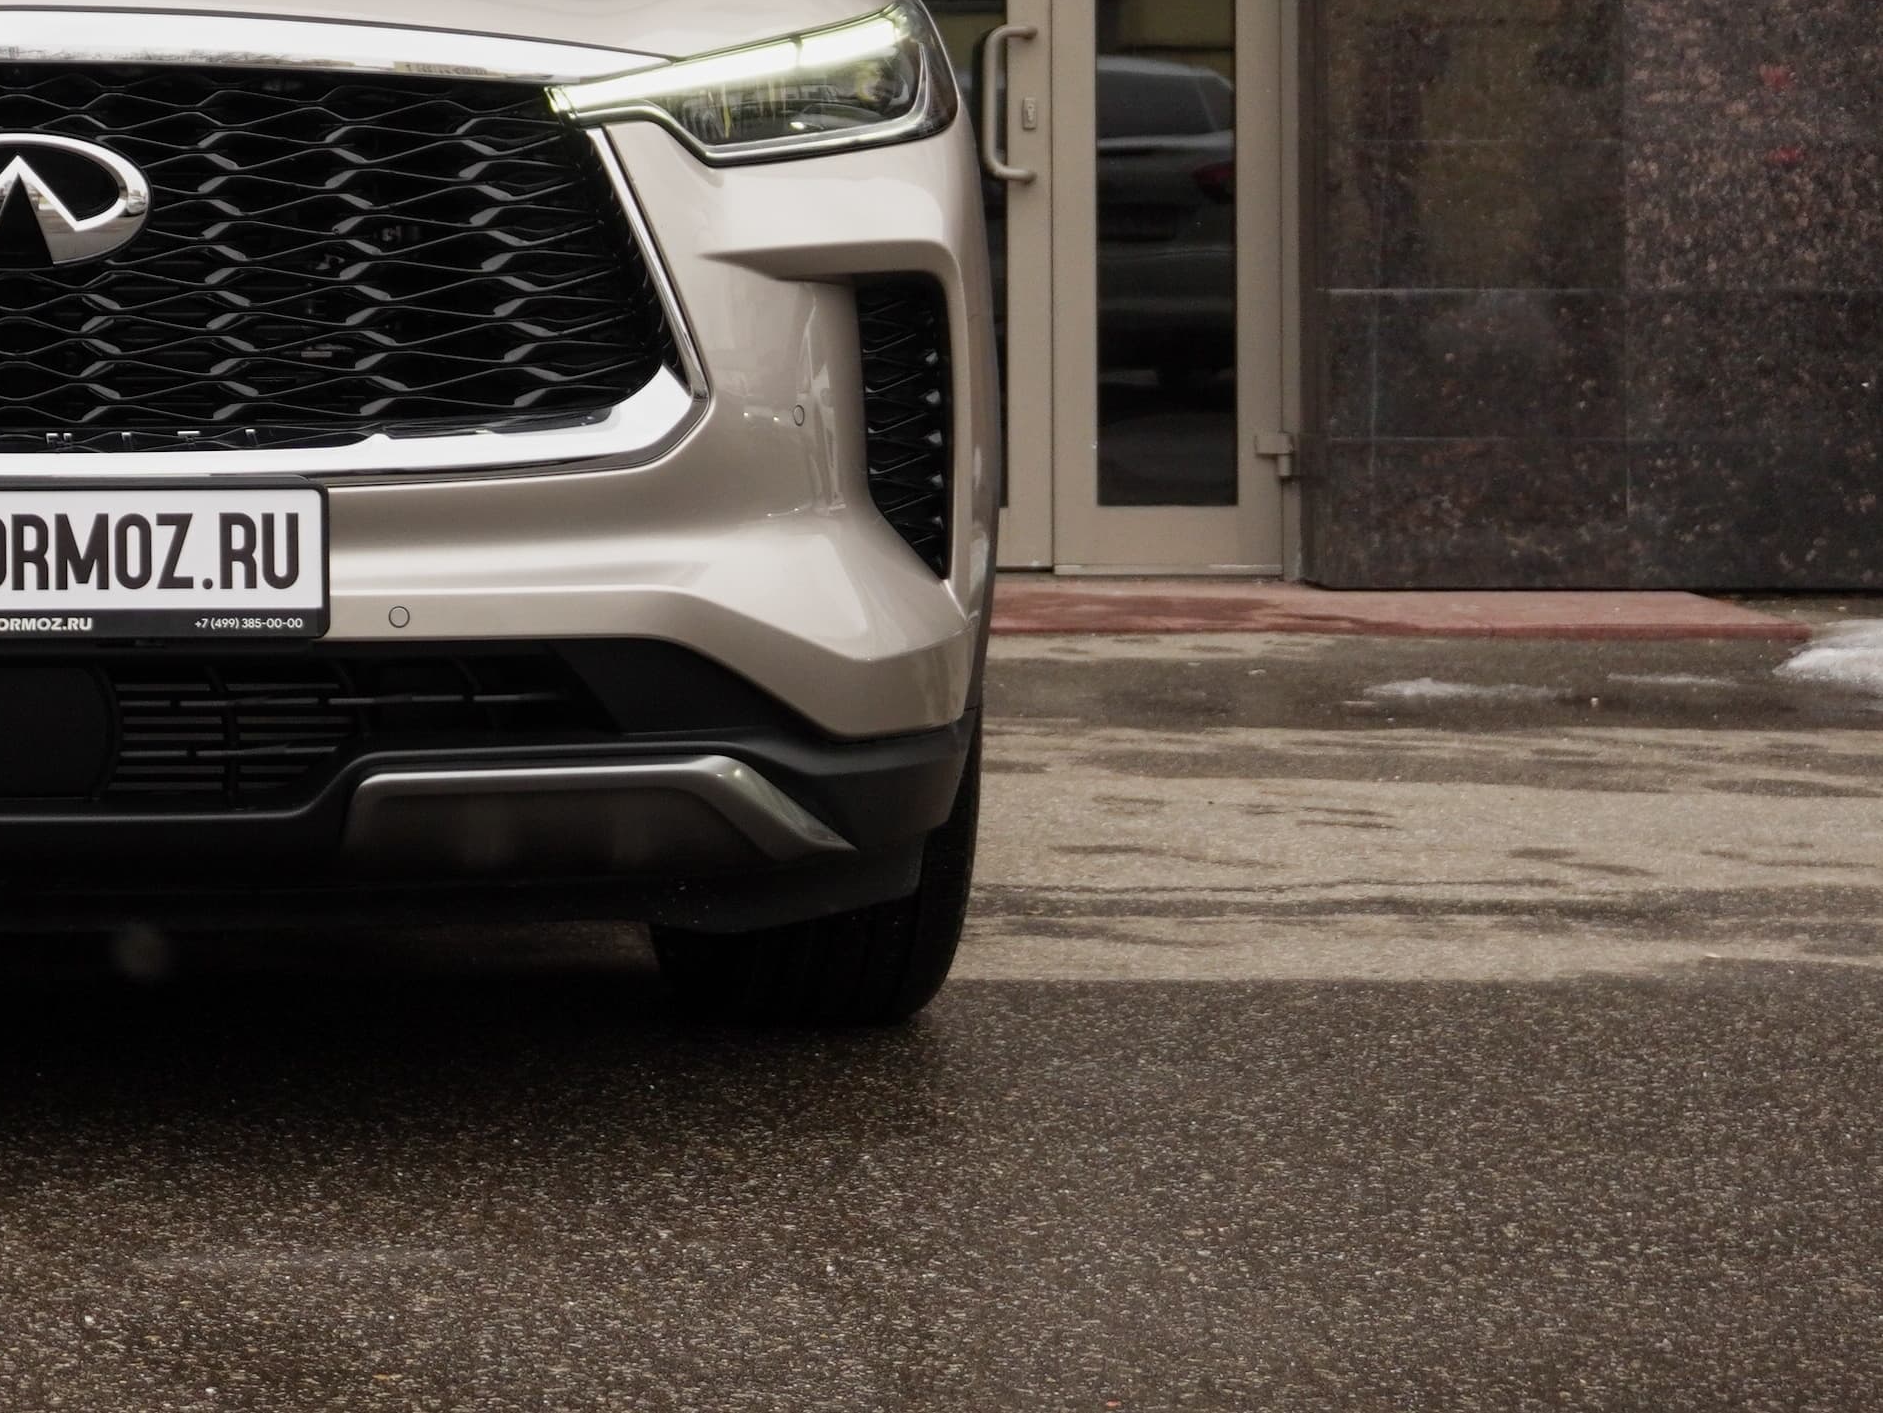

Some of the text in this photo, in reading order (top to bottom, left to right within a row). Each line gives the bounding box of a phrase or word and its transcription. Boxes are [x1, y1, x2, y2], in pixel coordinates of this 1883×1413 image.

[195, 618, 303, 630] +7 (499) 385-00-00
